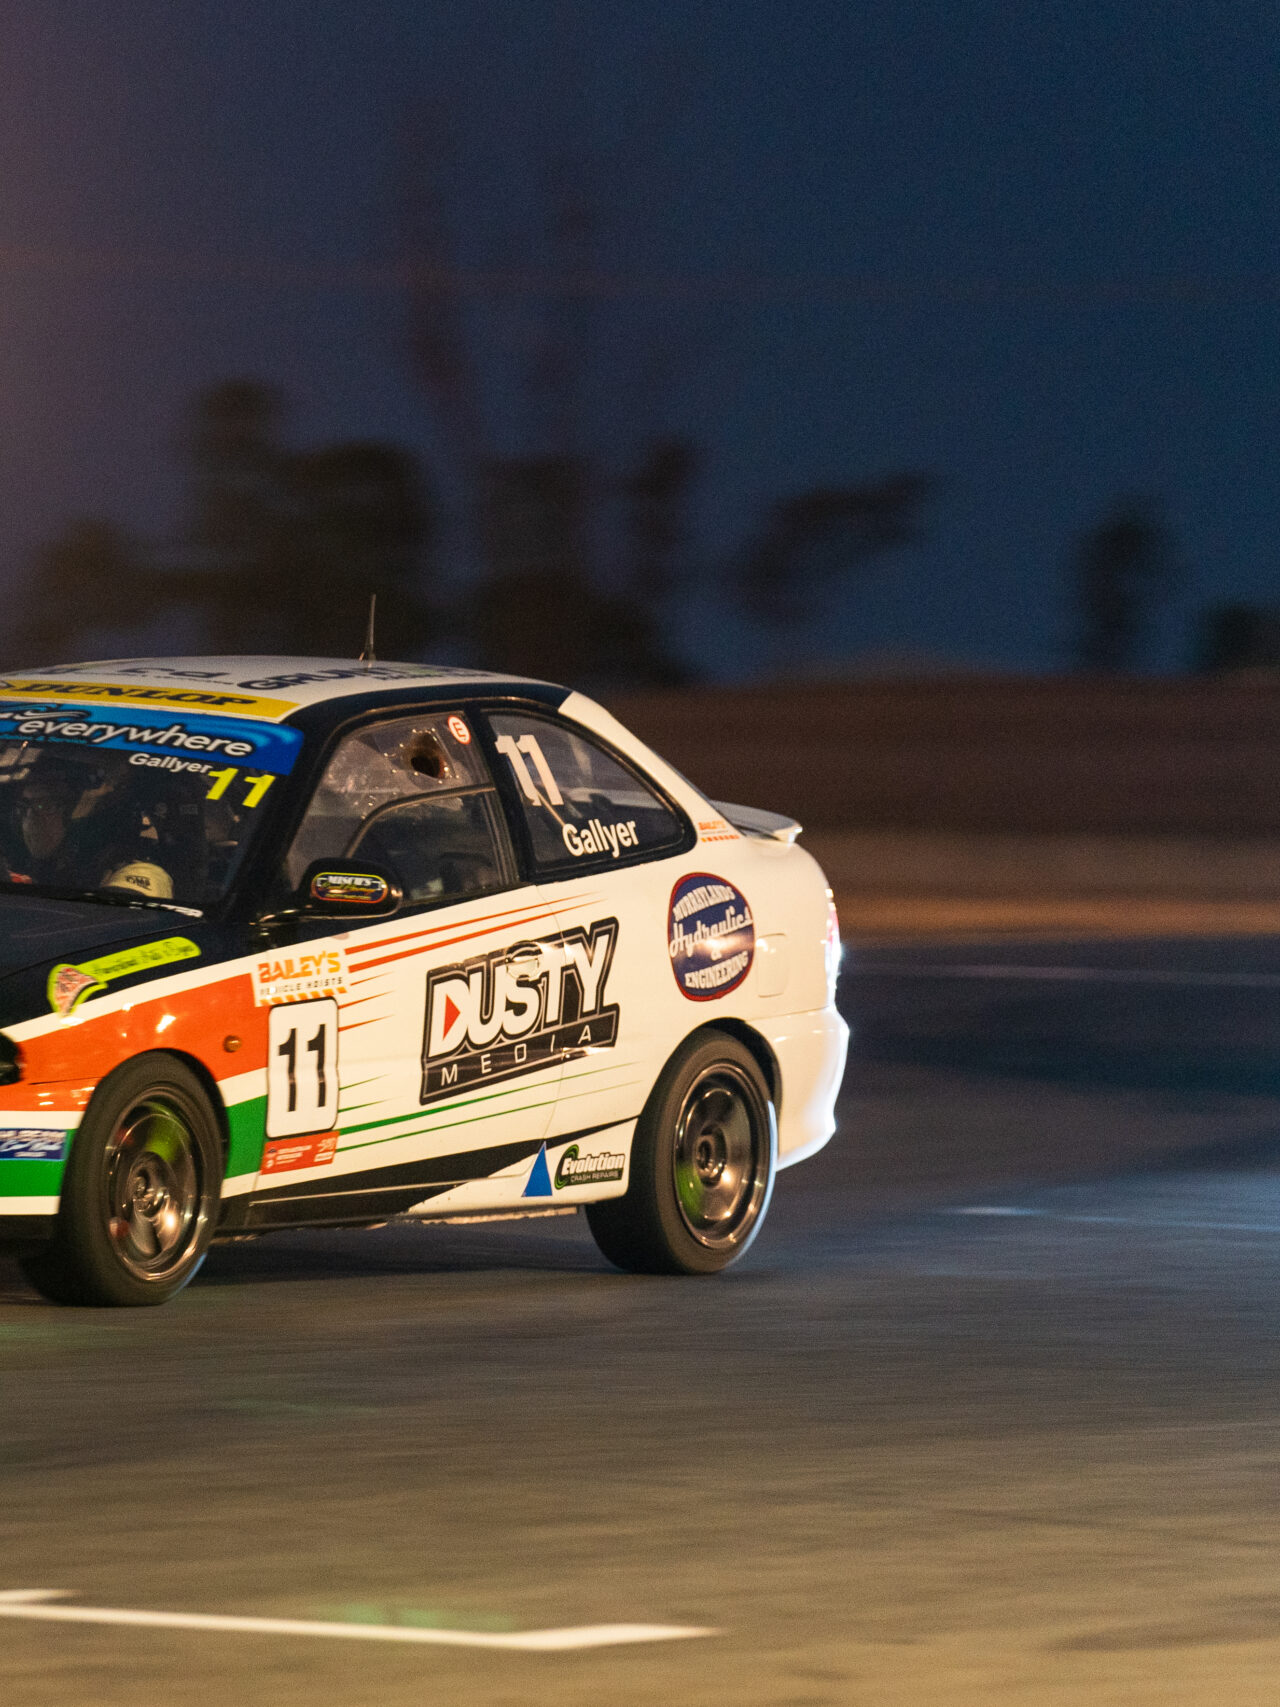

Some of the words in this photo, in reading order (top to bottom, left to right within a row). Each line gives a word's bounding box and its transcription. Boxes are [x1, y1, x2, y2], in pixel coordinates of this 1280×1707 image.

[15, 682, 258, 706] DUNLOP
[18, 719, 254, 757] everywhere
[128, 751, 214, 775] Gallyer
[494, 734, 565, 807] 11
[205, 766, 277, 809] 11
[562, 818, 640, 859] Gallyer
[257, 949, 342, 984] BAILEY'S
[428, 933, 611, 1058] DUSTY
[277, 1023, 327, 1113] 11
[440, 1024, 593, 1087] MEDIA
[560, 1153, 625, 1177] Evolution
